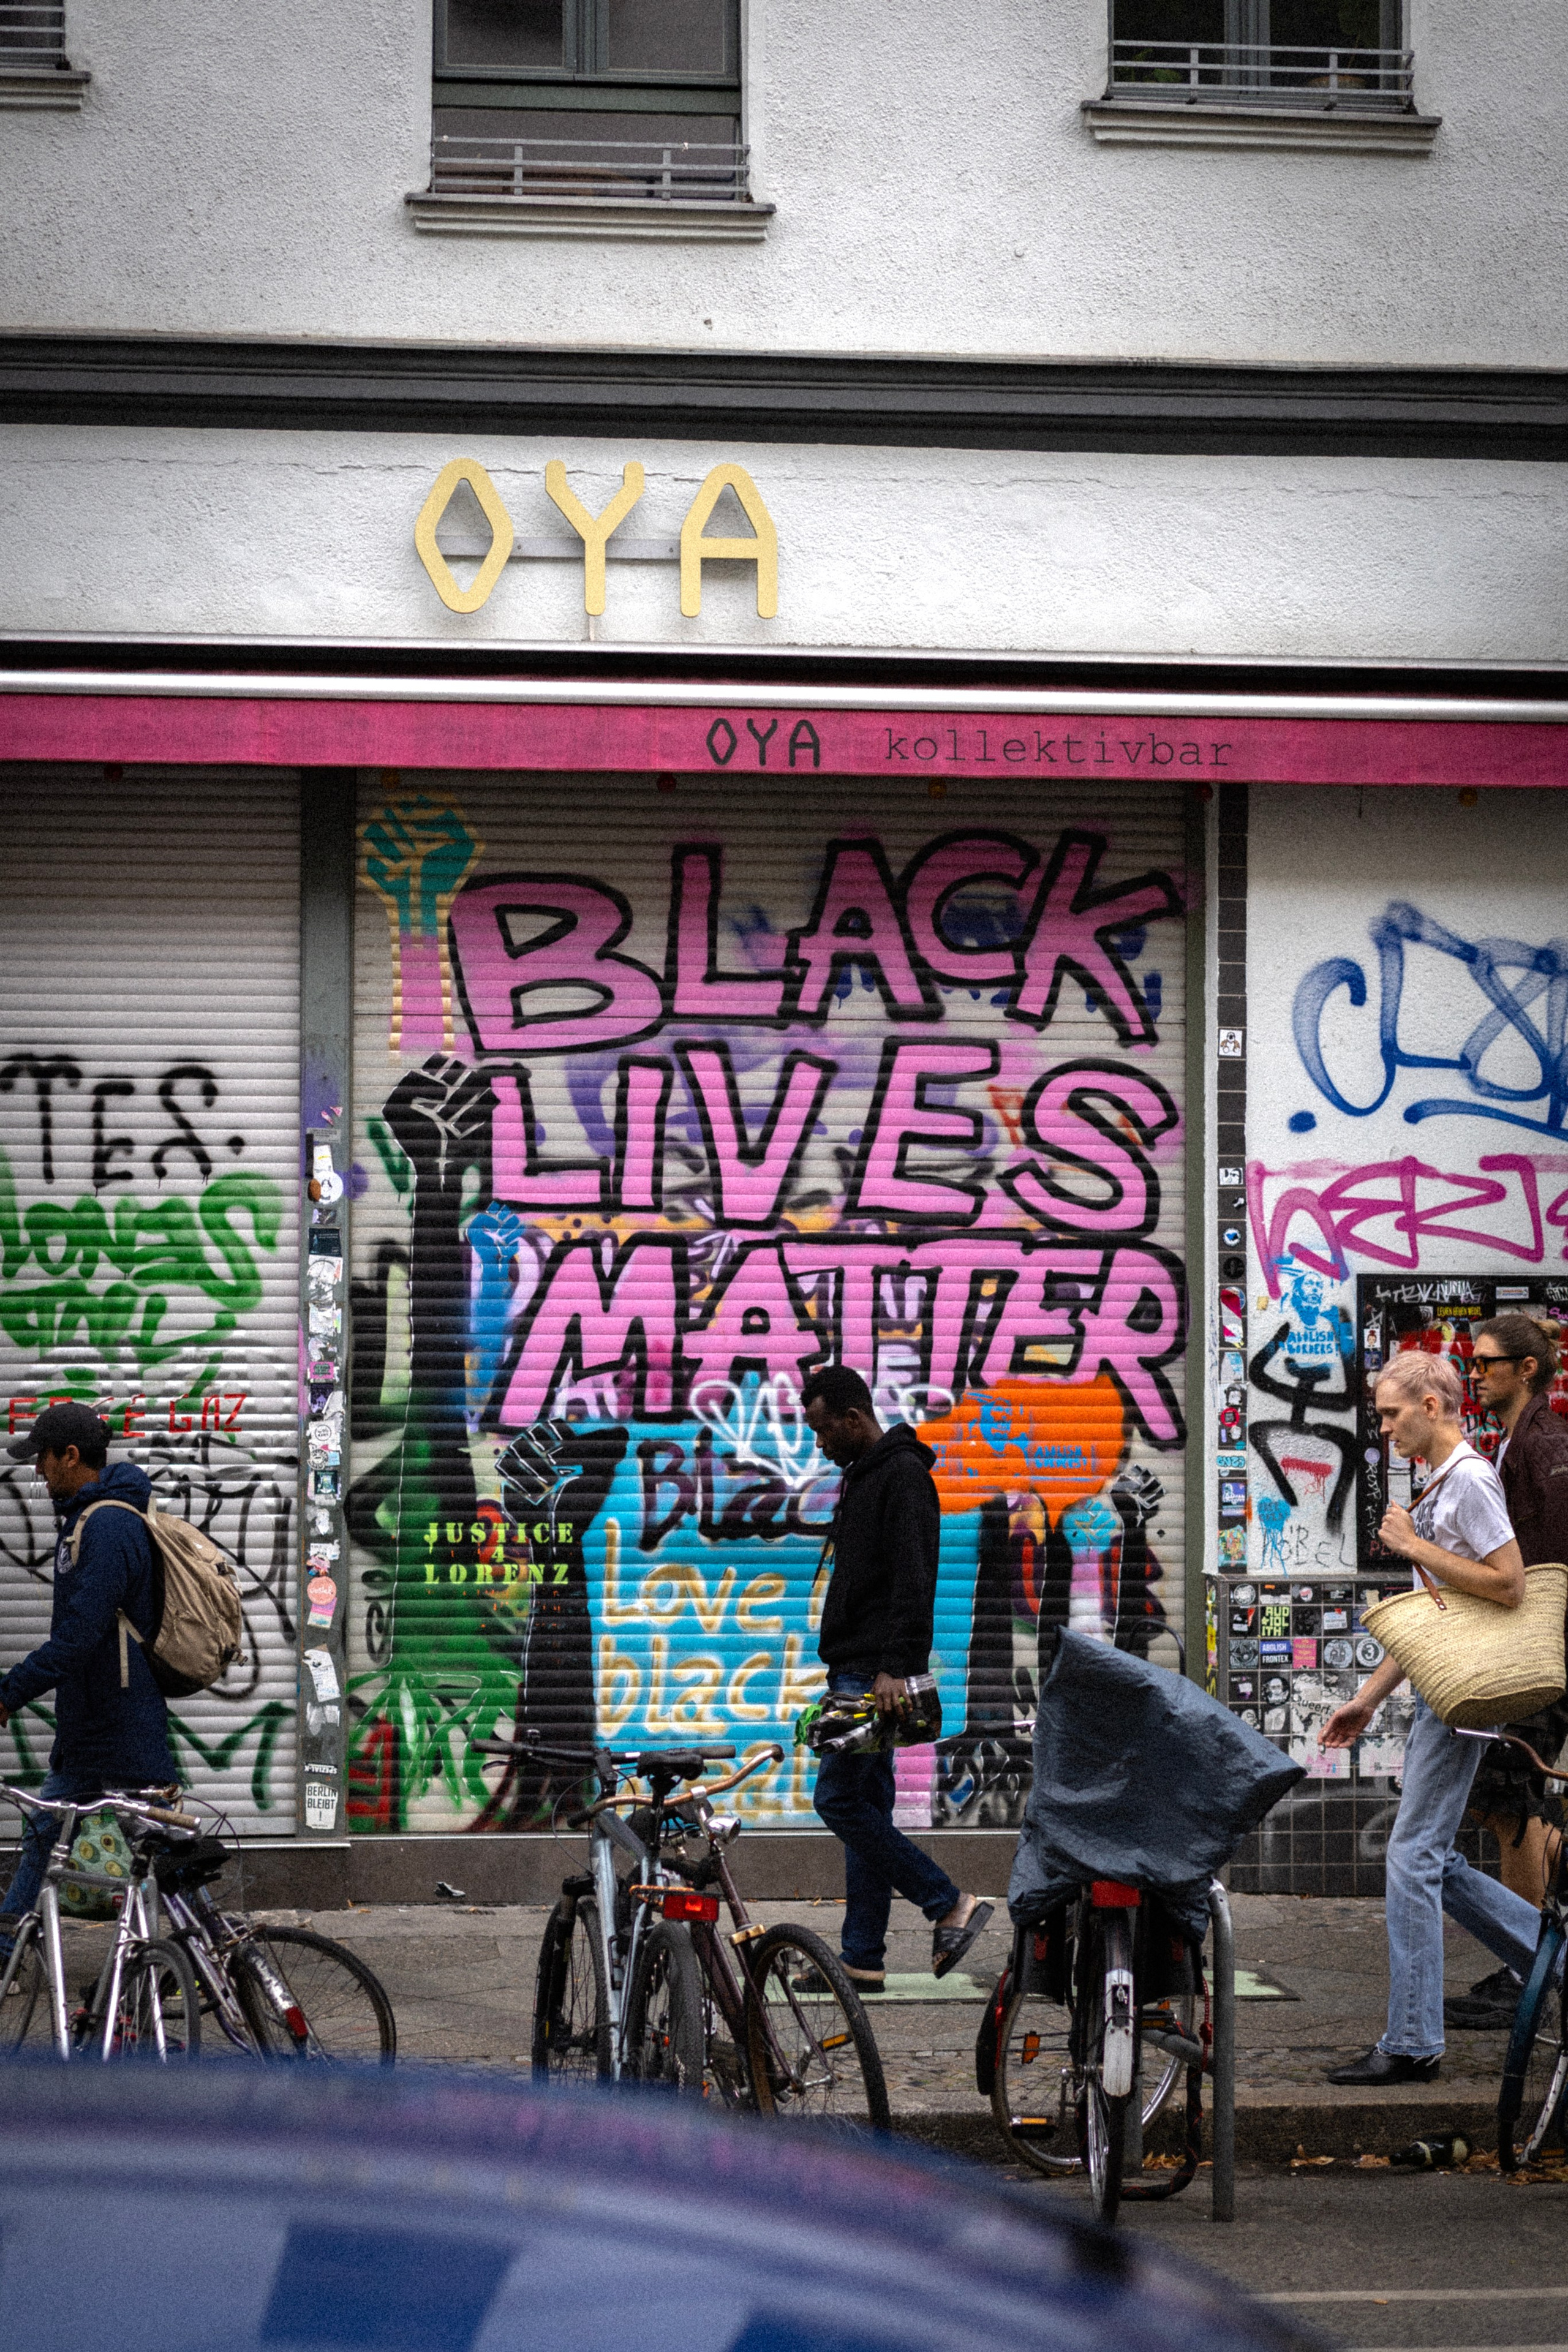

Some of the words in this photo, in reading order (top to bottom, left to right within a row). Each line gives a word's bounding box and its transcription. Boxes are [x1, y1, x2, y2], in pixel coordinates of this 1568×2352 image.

[415, 457, 778, 619] OYA
[706, 717, 821, 768] OYA
[885, 729, 1233, 767] kollektivbar
[448, 830, 1186, 1058] BLACK
[488, 1036, 1180, 1240] LIVES
[483, 1229, 1189, 1452] MATTER
[423, 1522, 573, 1547] JUSTICE
[491, 1544, 505, 1562] 4
[424, 1564, 569, 1585] LORENZ
[601, 1517, 789, 1634] Love
[1262, 1643, 1287, 1652] ABOLISH
[1262, 1654, 1289, 1664] FRONTEX
[595, 1633, 828, 1738] black
[307, 1785, 337, 1798] BERLIN
[307, 1798, 335, 1809] BLEIBT
